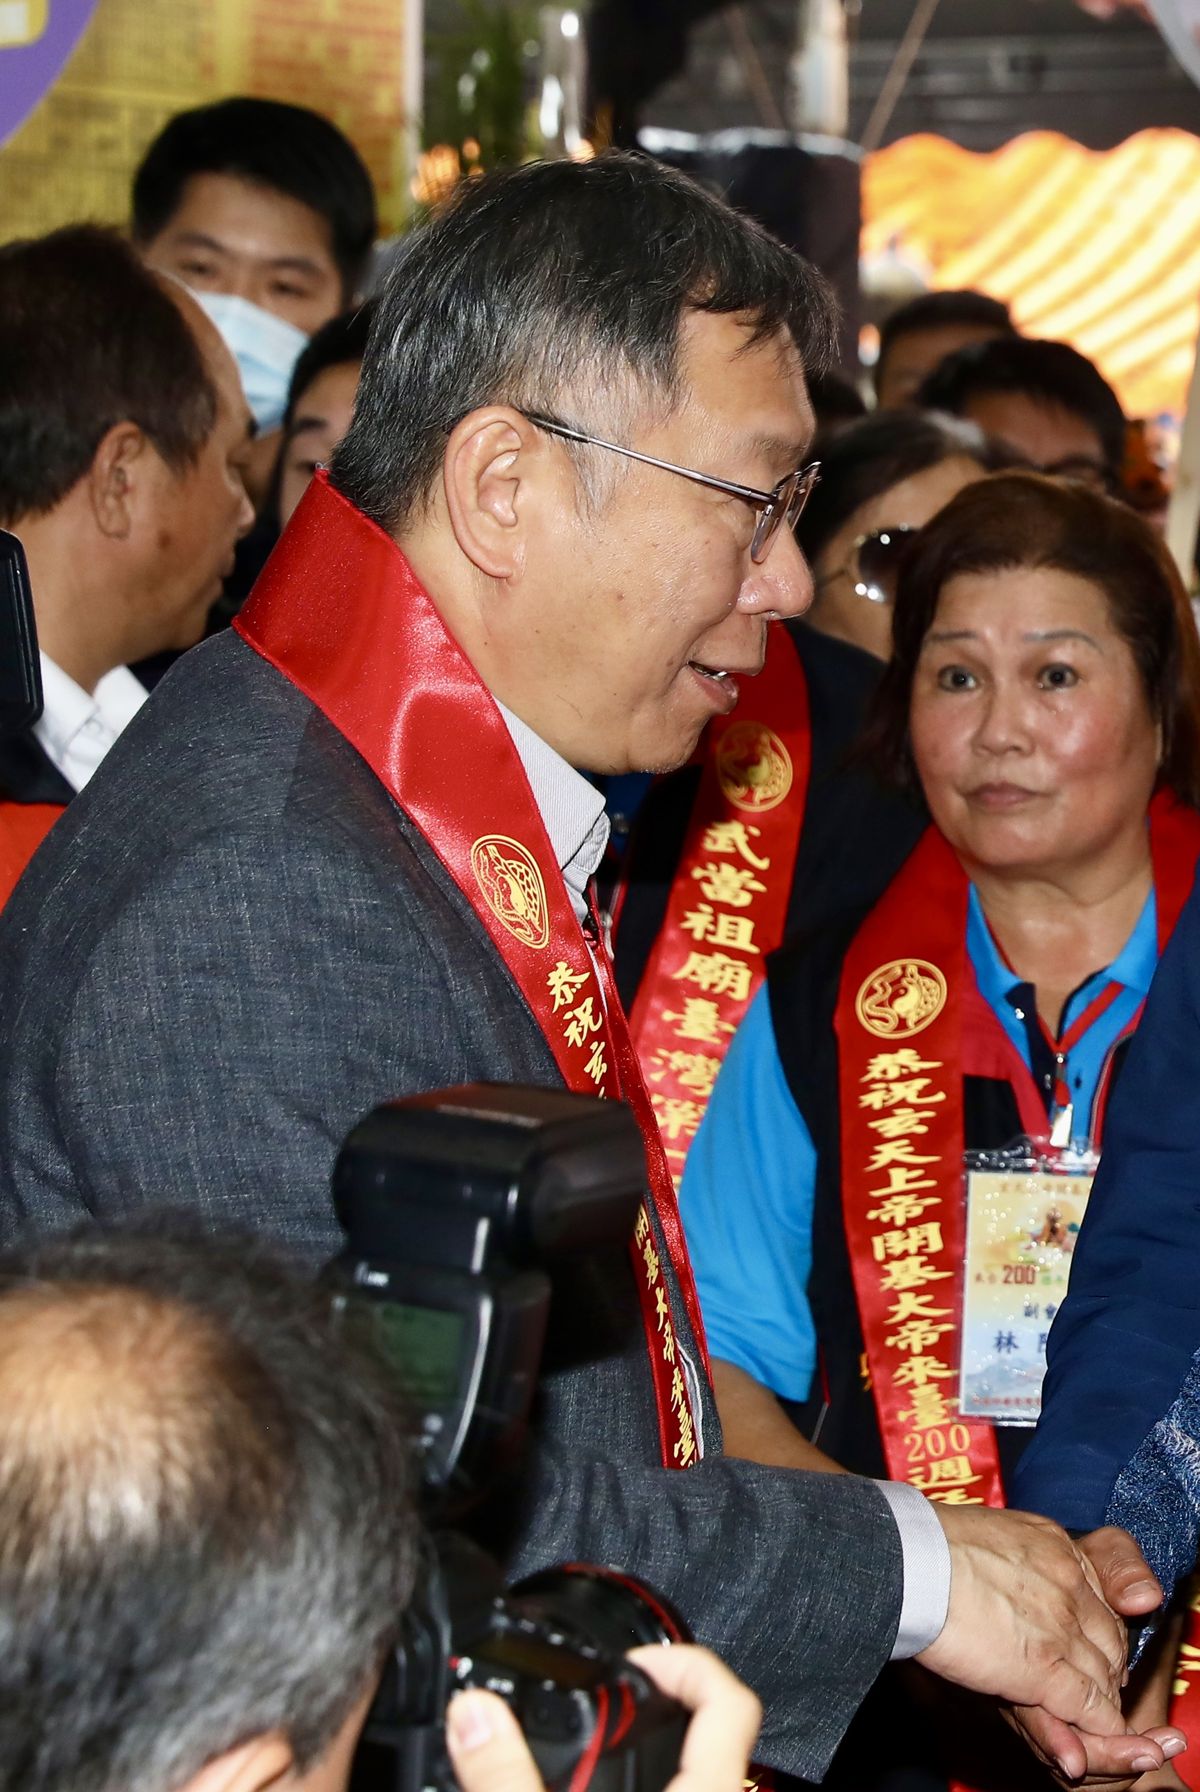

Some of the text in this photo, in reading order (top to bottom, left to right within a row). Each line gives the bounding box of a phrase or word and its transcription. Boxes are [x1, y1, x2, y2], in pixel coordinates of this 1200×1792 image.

[651, 819, 771, 1190] 武當祖廟臺灣第
